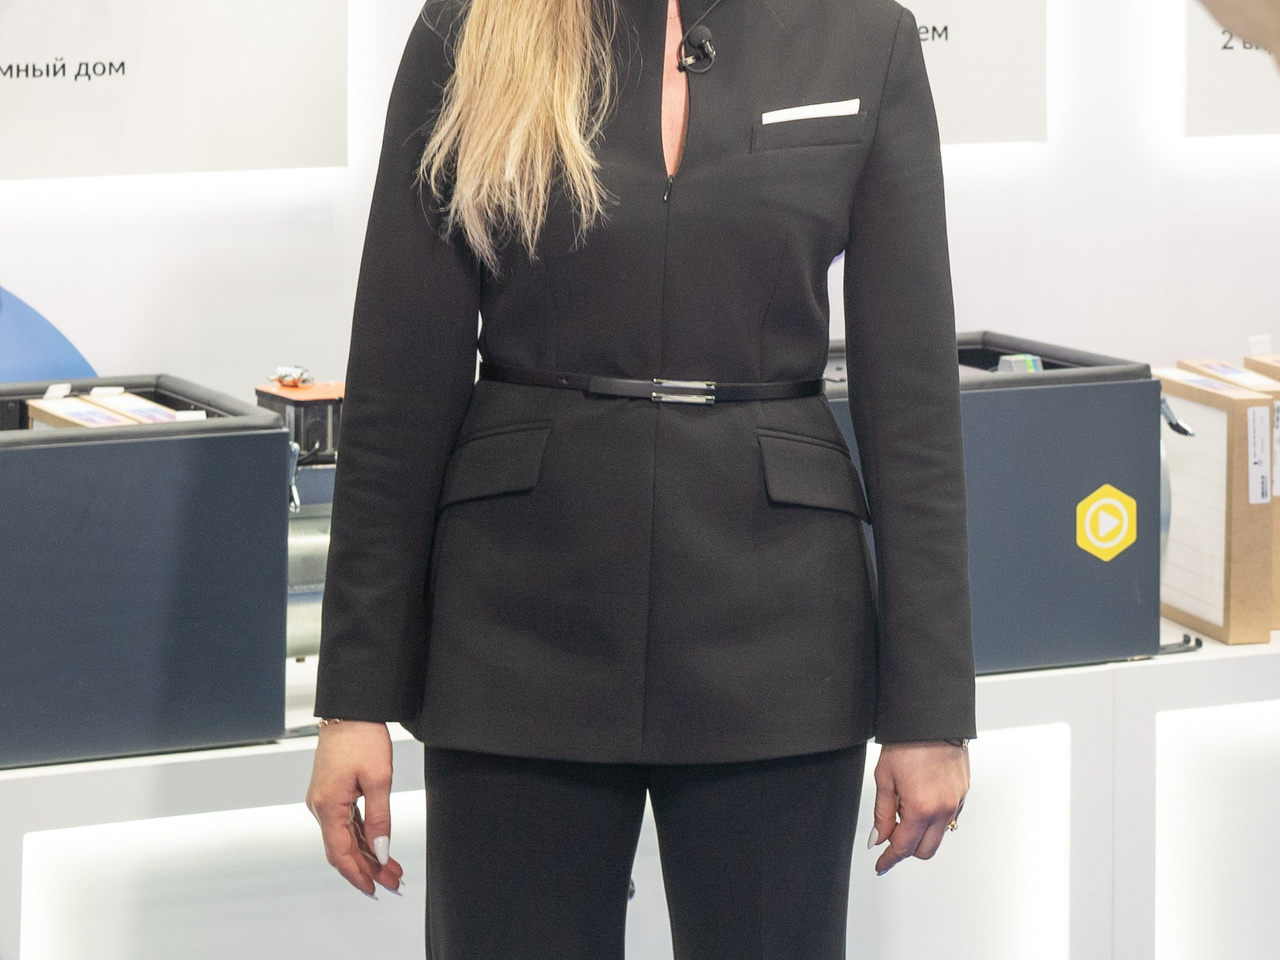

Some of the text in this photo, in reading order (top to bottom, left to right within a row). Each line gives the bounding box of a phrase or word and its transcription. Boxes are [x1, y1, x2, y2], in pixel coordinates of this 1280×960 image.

[918, 25, 949, 42] ем
[1222, 29, 1235, 50] 2
[74, 61, 126, 82] дом
